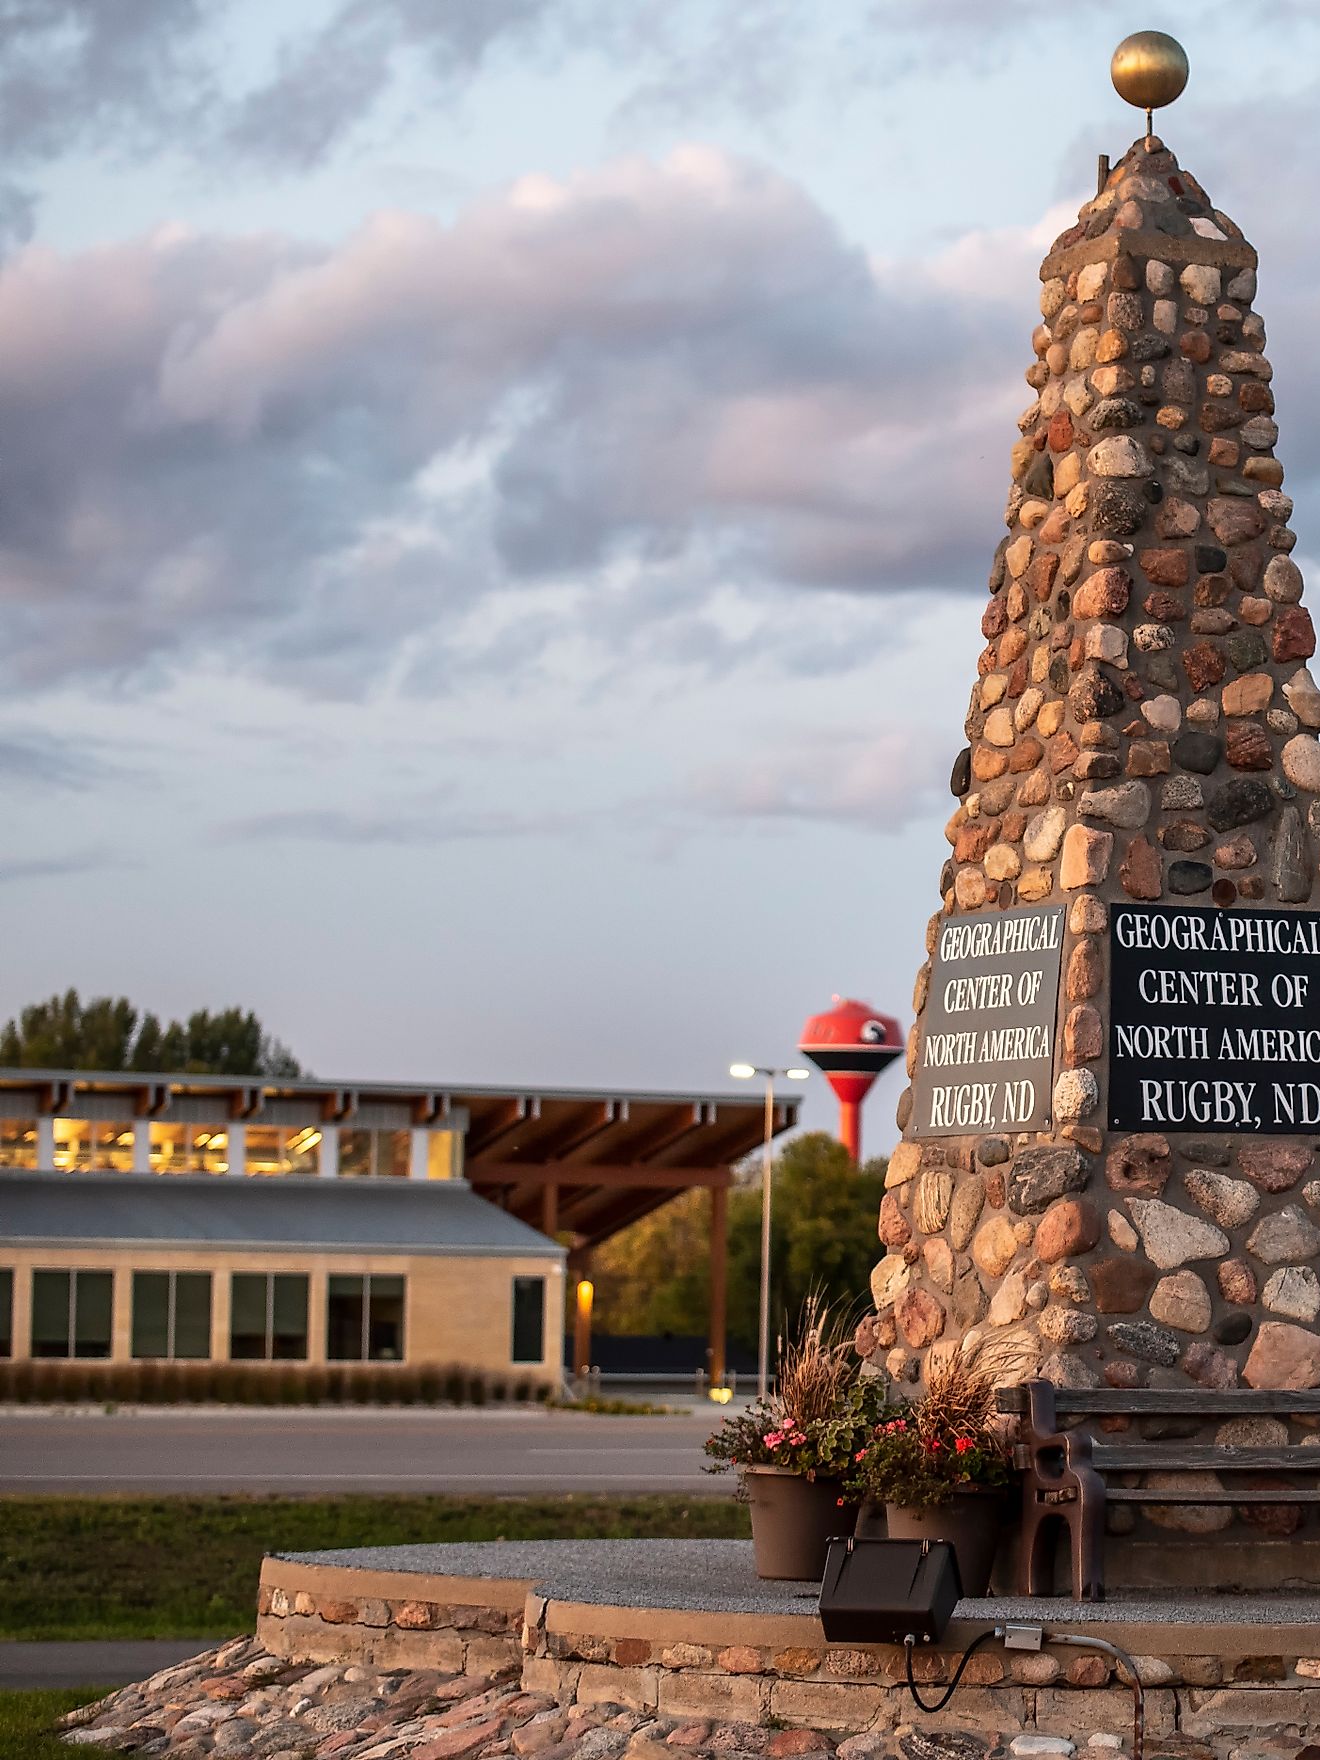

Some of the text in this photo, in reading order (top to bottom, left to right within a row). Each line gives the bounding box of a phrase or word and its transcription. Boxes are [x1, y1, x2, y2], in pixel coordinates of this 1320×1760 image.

[940, 914, 1060, 962] GEOGRAPHICAL
[944, 970, 1043, 1013] CENTER OF
[1138, 968, 1309, 1008] CENTER OF
[923, 1024, 1050, 1067] NORTH AMERICA
[1114, 1024, 1211, 1060] NORTH
[929, 1079, 1035, 1130] RUGBY, ND
[1139, 1079, 1262, 1129] RUGBY,
